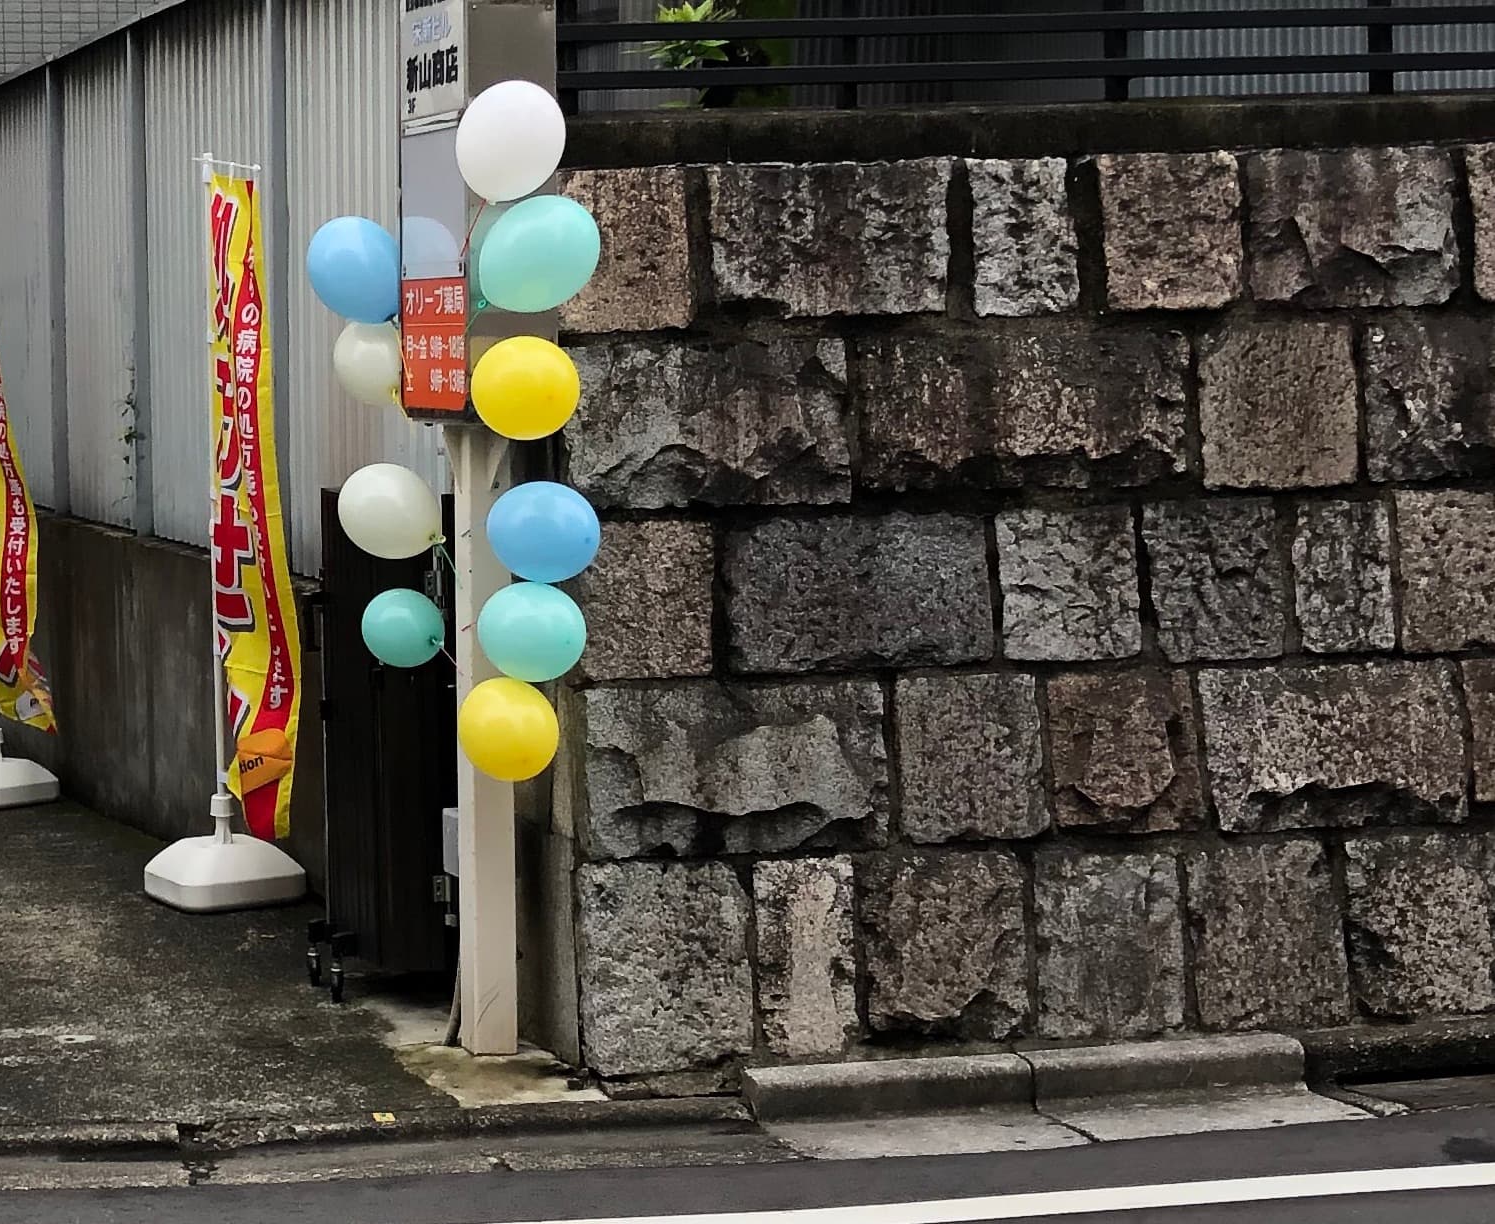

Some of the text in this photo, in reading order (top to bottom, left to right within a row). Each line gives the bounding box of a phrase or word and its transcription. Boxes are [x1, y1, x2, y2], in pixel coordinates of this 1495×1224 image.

[406, 44, 458, 93] 新山商店
[405, 285, 464, 315] オリーブ薬局
